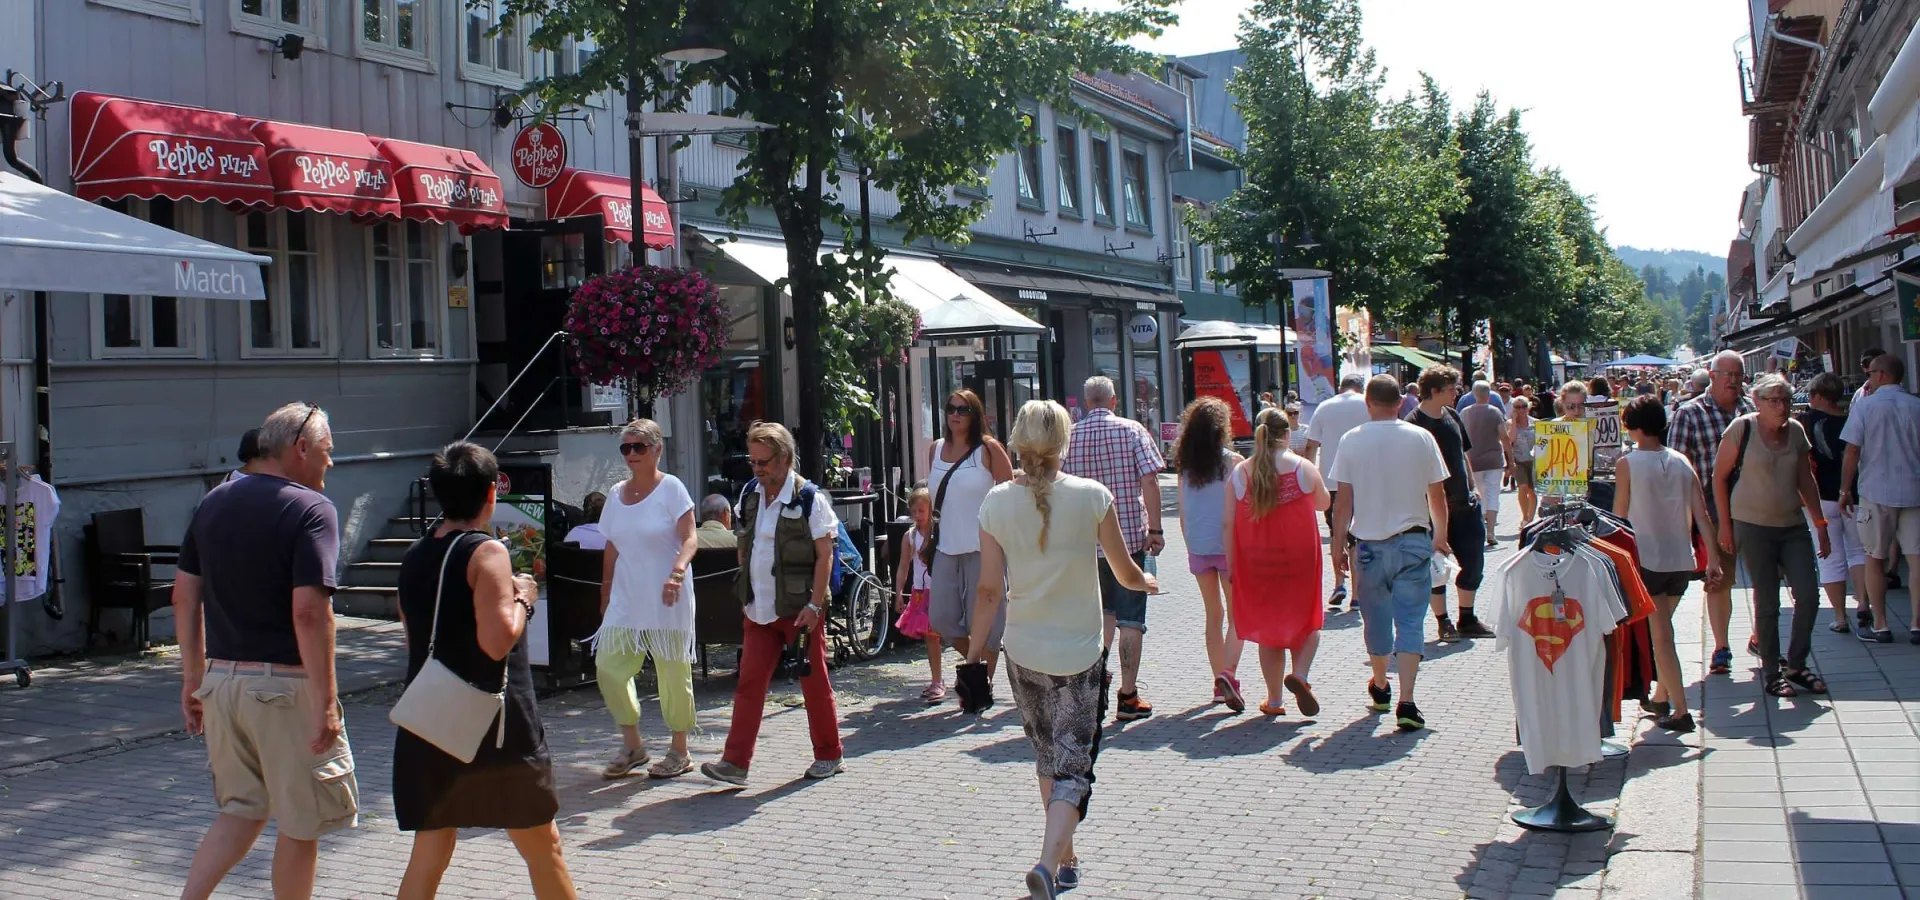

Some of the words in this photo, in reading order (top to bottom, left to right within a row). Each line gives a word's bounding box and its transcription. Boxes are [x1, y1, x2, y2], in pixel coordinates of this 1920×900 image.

[149, 139, 215, 176] Peppes
[219, 154, 259, 177] PIZZA
[516, 144, 559, 168] Peppes
[295, 155, 351, 189] Peppes
[353, 168, 388, 190] PIZZA
[420, 173, 467, 205] Peppes
[469, 187, 498, 208] PIZZA
[645, 210, 667, 229] PIZZA
[174, 261, 247, 295] Match
[1131, 324, 1153, 334] VITA
[1536, 479, 1588, 487] sommer
[519, 502, 544, 519] NEW
